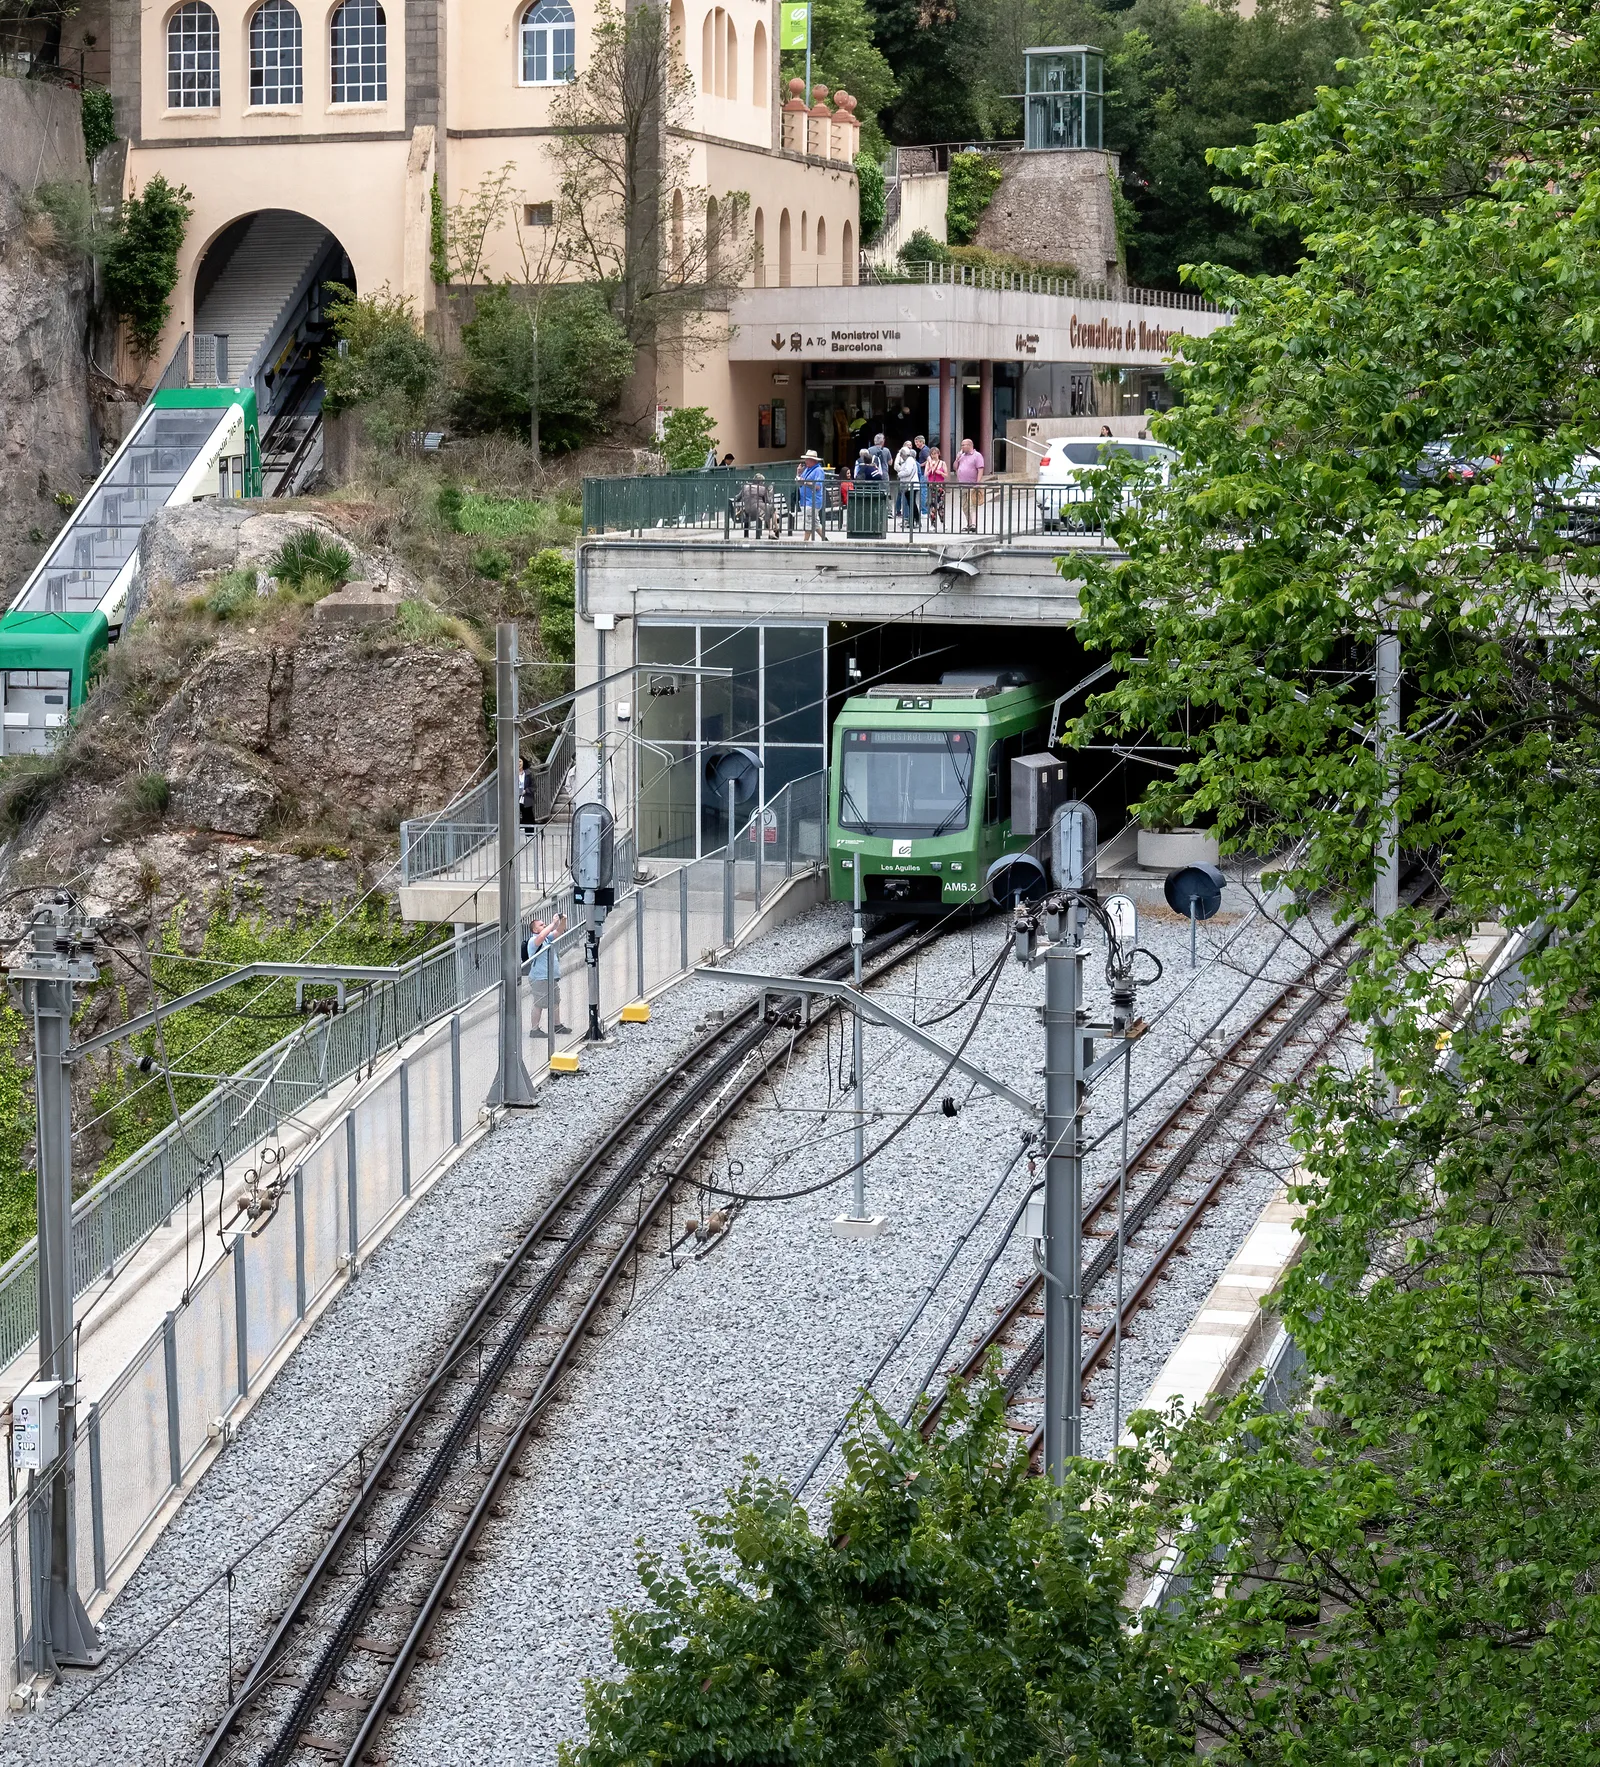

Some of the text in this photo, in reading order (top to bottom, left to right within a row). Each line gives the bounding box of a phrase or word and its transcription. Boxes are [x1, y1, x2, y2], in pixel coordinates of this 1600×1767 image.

[831, 330, 901, 340] Monistrol Vila
[1069, 314, 1123, 351] Cremallera
[1125, 319, 1136, 351] de
[806, 337, 827, 346] A To
[831, 342, 883, 352] Barcelona
[943, 882, 977, 892] AM5.2
[19, 1442, 36, 1451] 1UP
